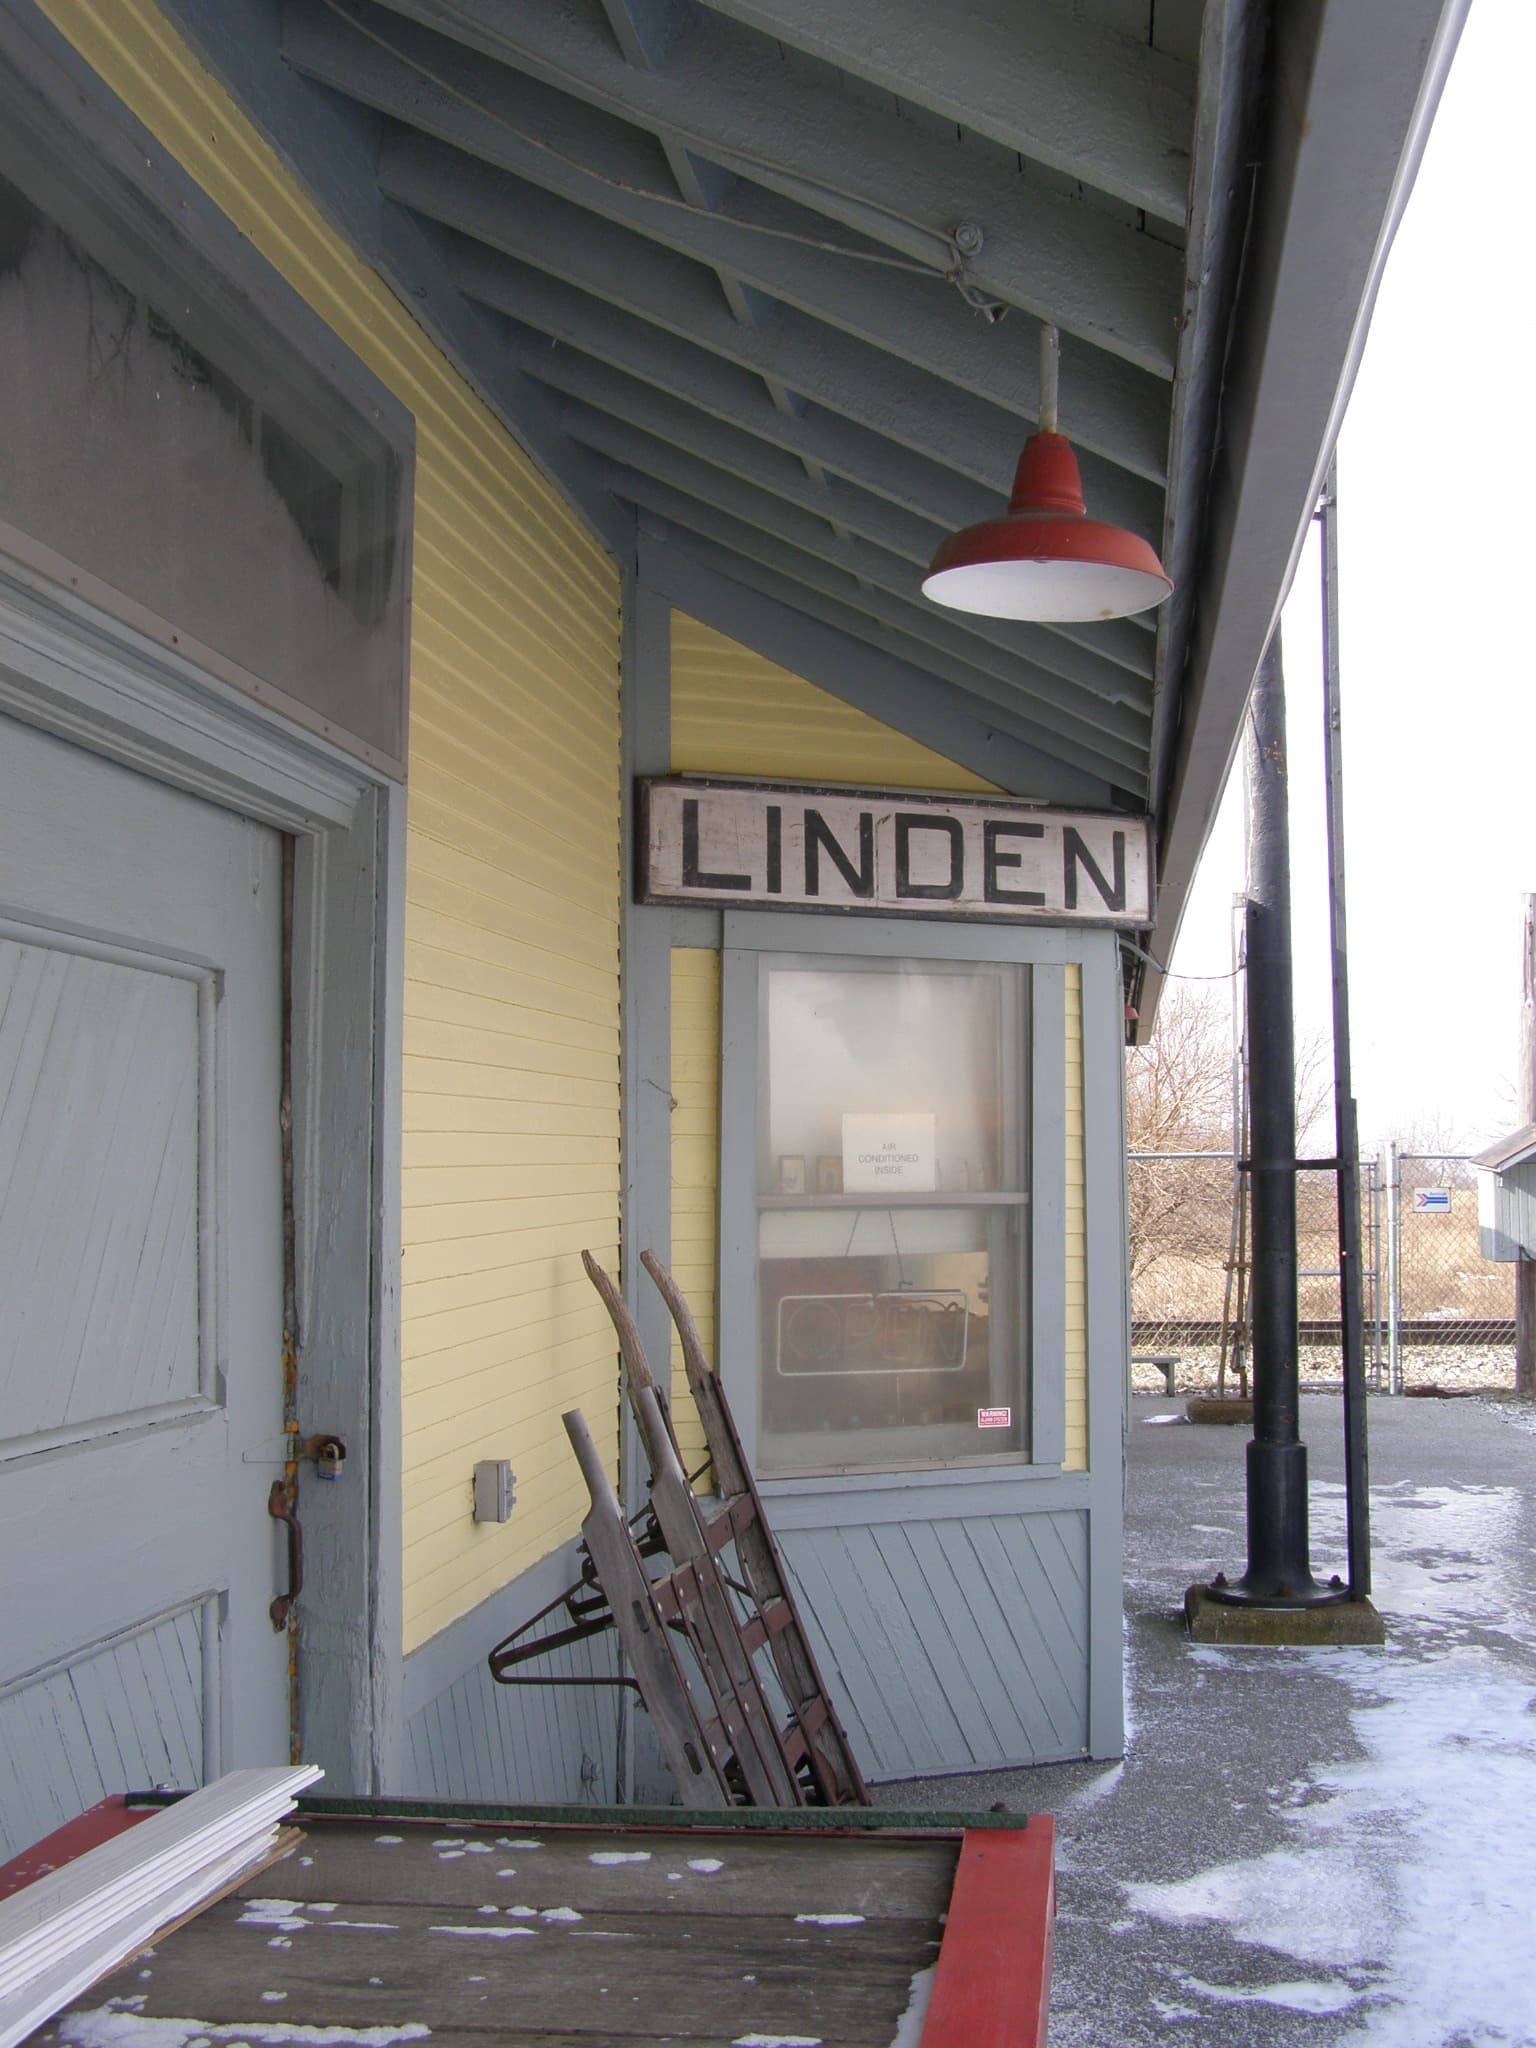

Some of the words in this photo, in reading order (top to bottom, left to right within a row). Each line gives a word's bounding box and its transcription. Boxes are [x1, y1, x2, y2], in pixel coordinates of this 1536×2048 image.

[682, 798, 1126, 913] LINDEN
[881, 1142, 897, 1152] AIR
[858, 1153, 920, 1164] CONDITIONED
[874, 1165, 904, 1175] INSIDE
